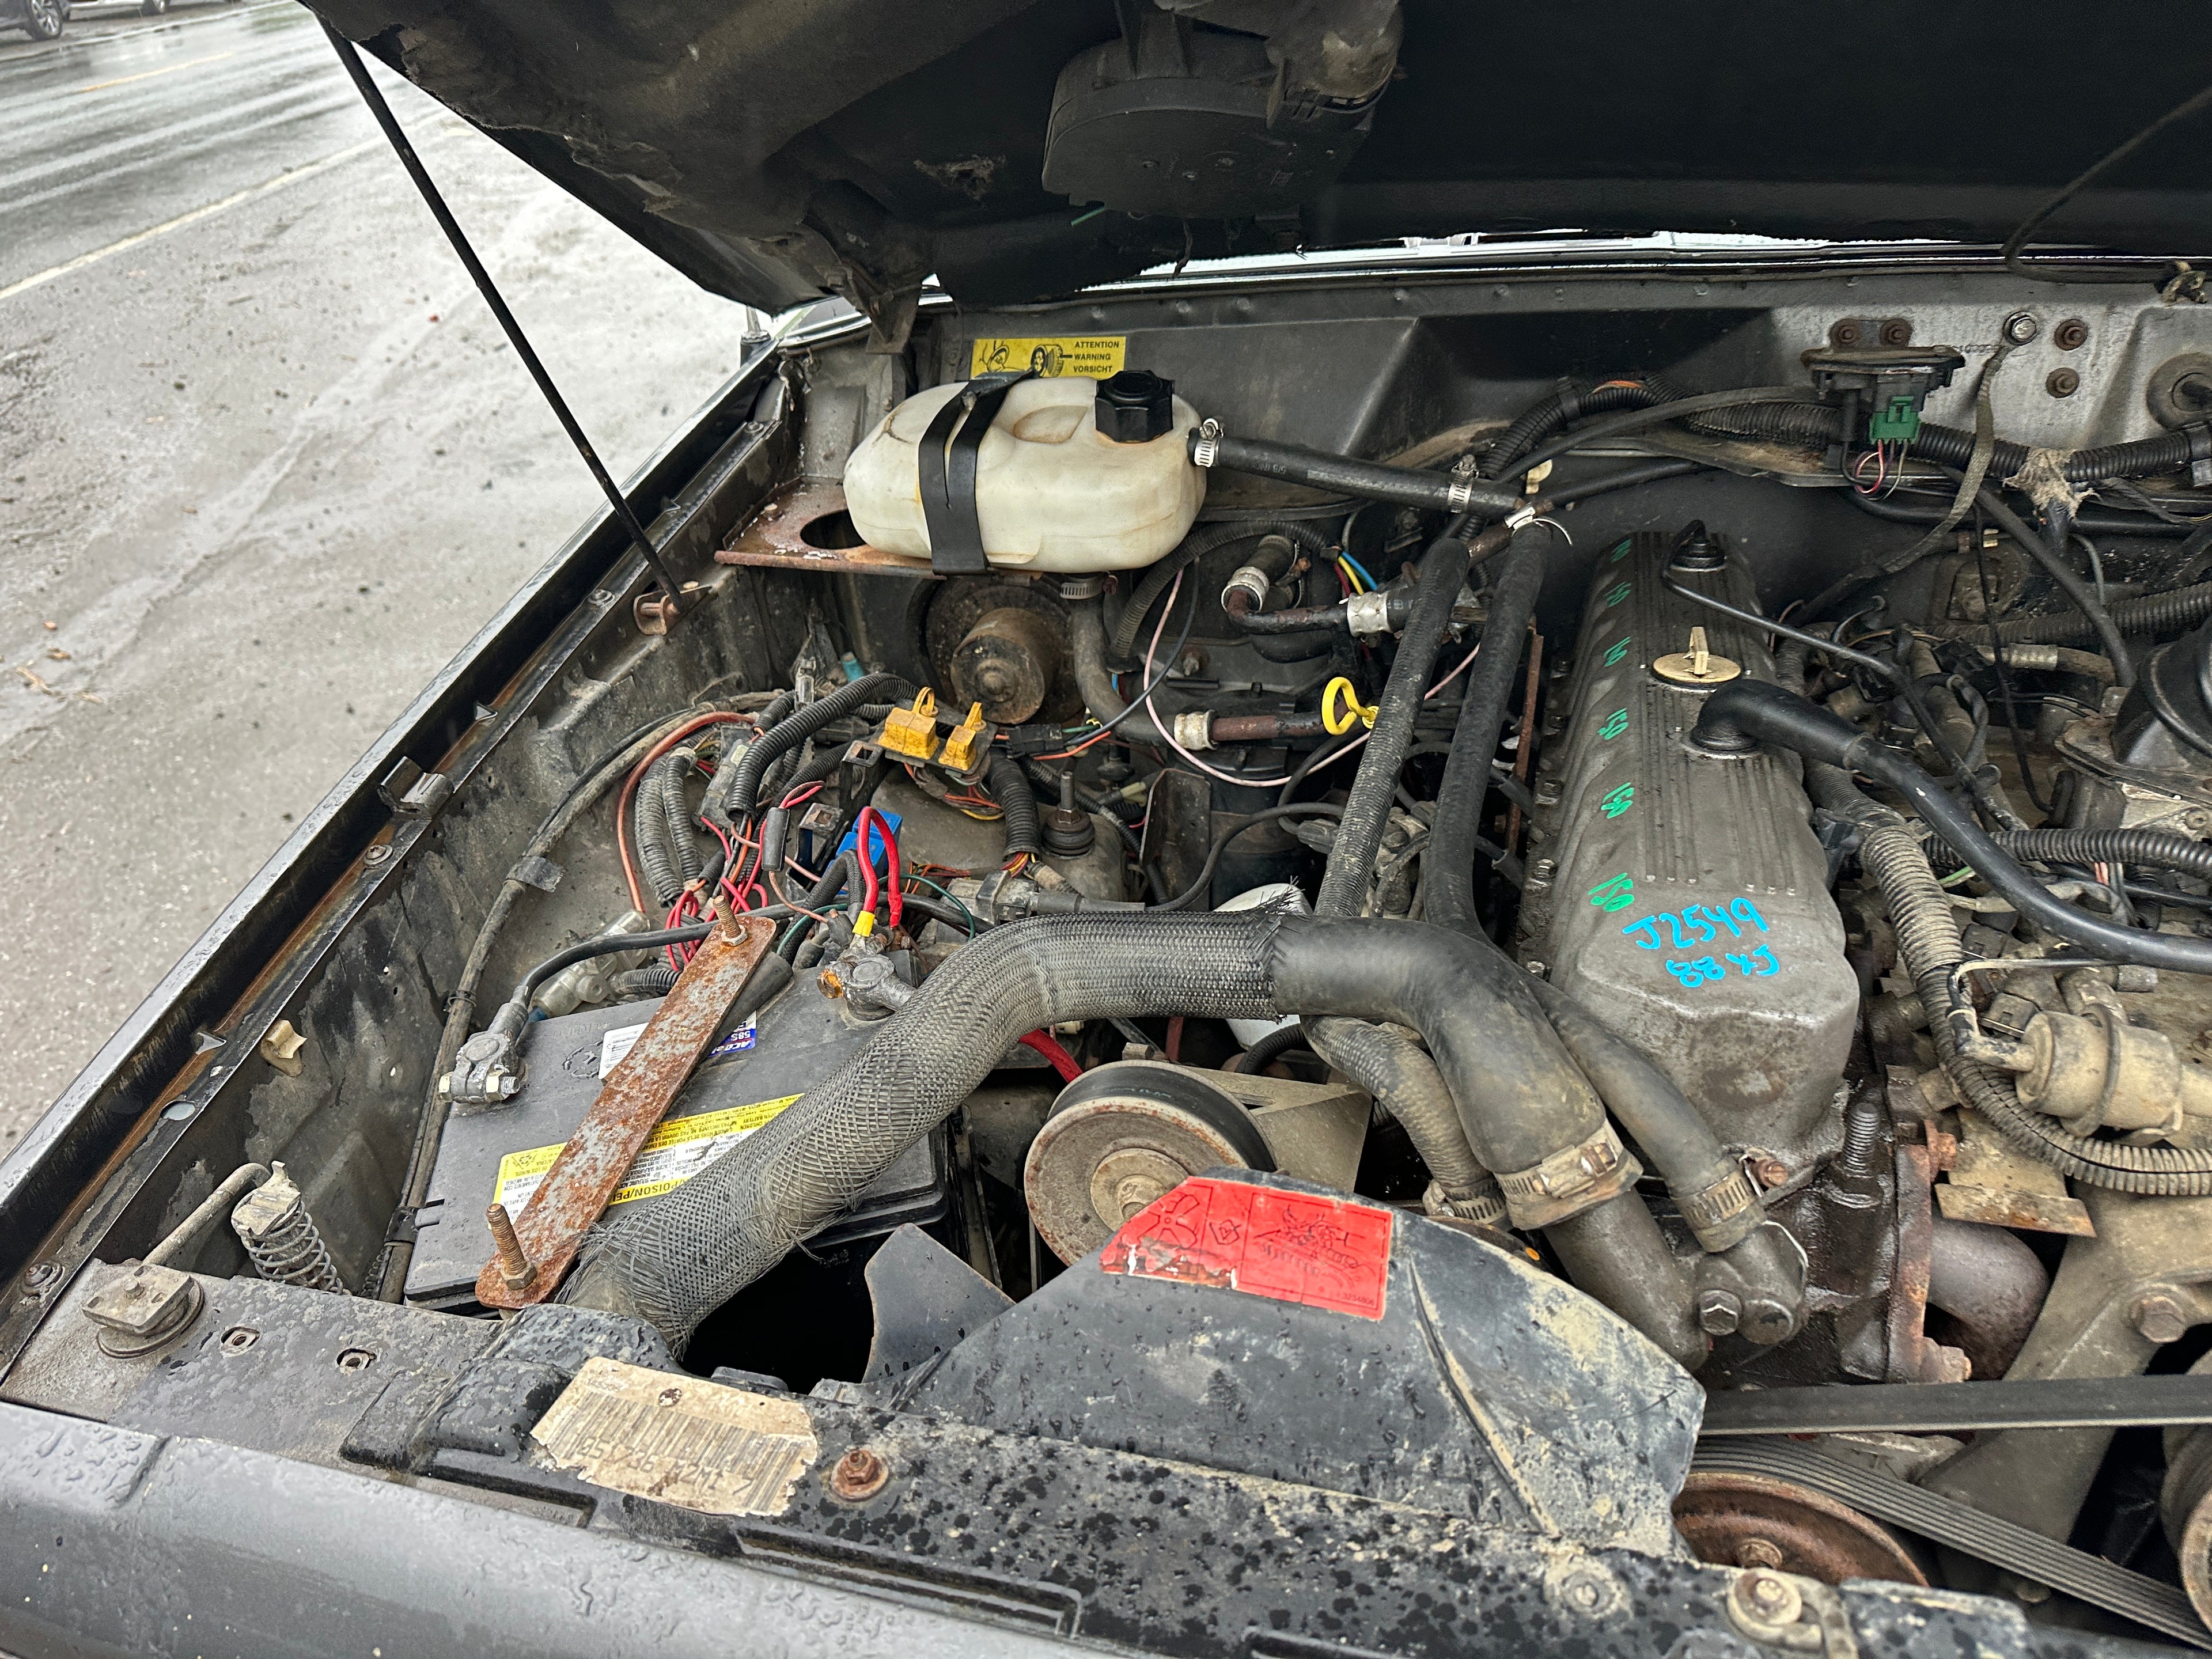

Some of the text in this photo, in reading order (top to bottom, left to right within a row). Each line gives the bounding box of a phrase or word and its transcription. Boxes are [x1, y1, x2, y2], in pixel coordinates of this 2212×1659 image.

[1597, 707, 1628, 740] 150
[1588, 872, 1634, 912] 150
[1622, 897, 1769, 949] J2549
[1666, 956, 1725, 988] 88
